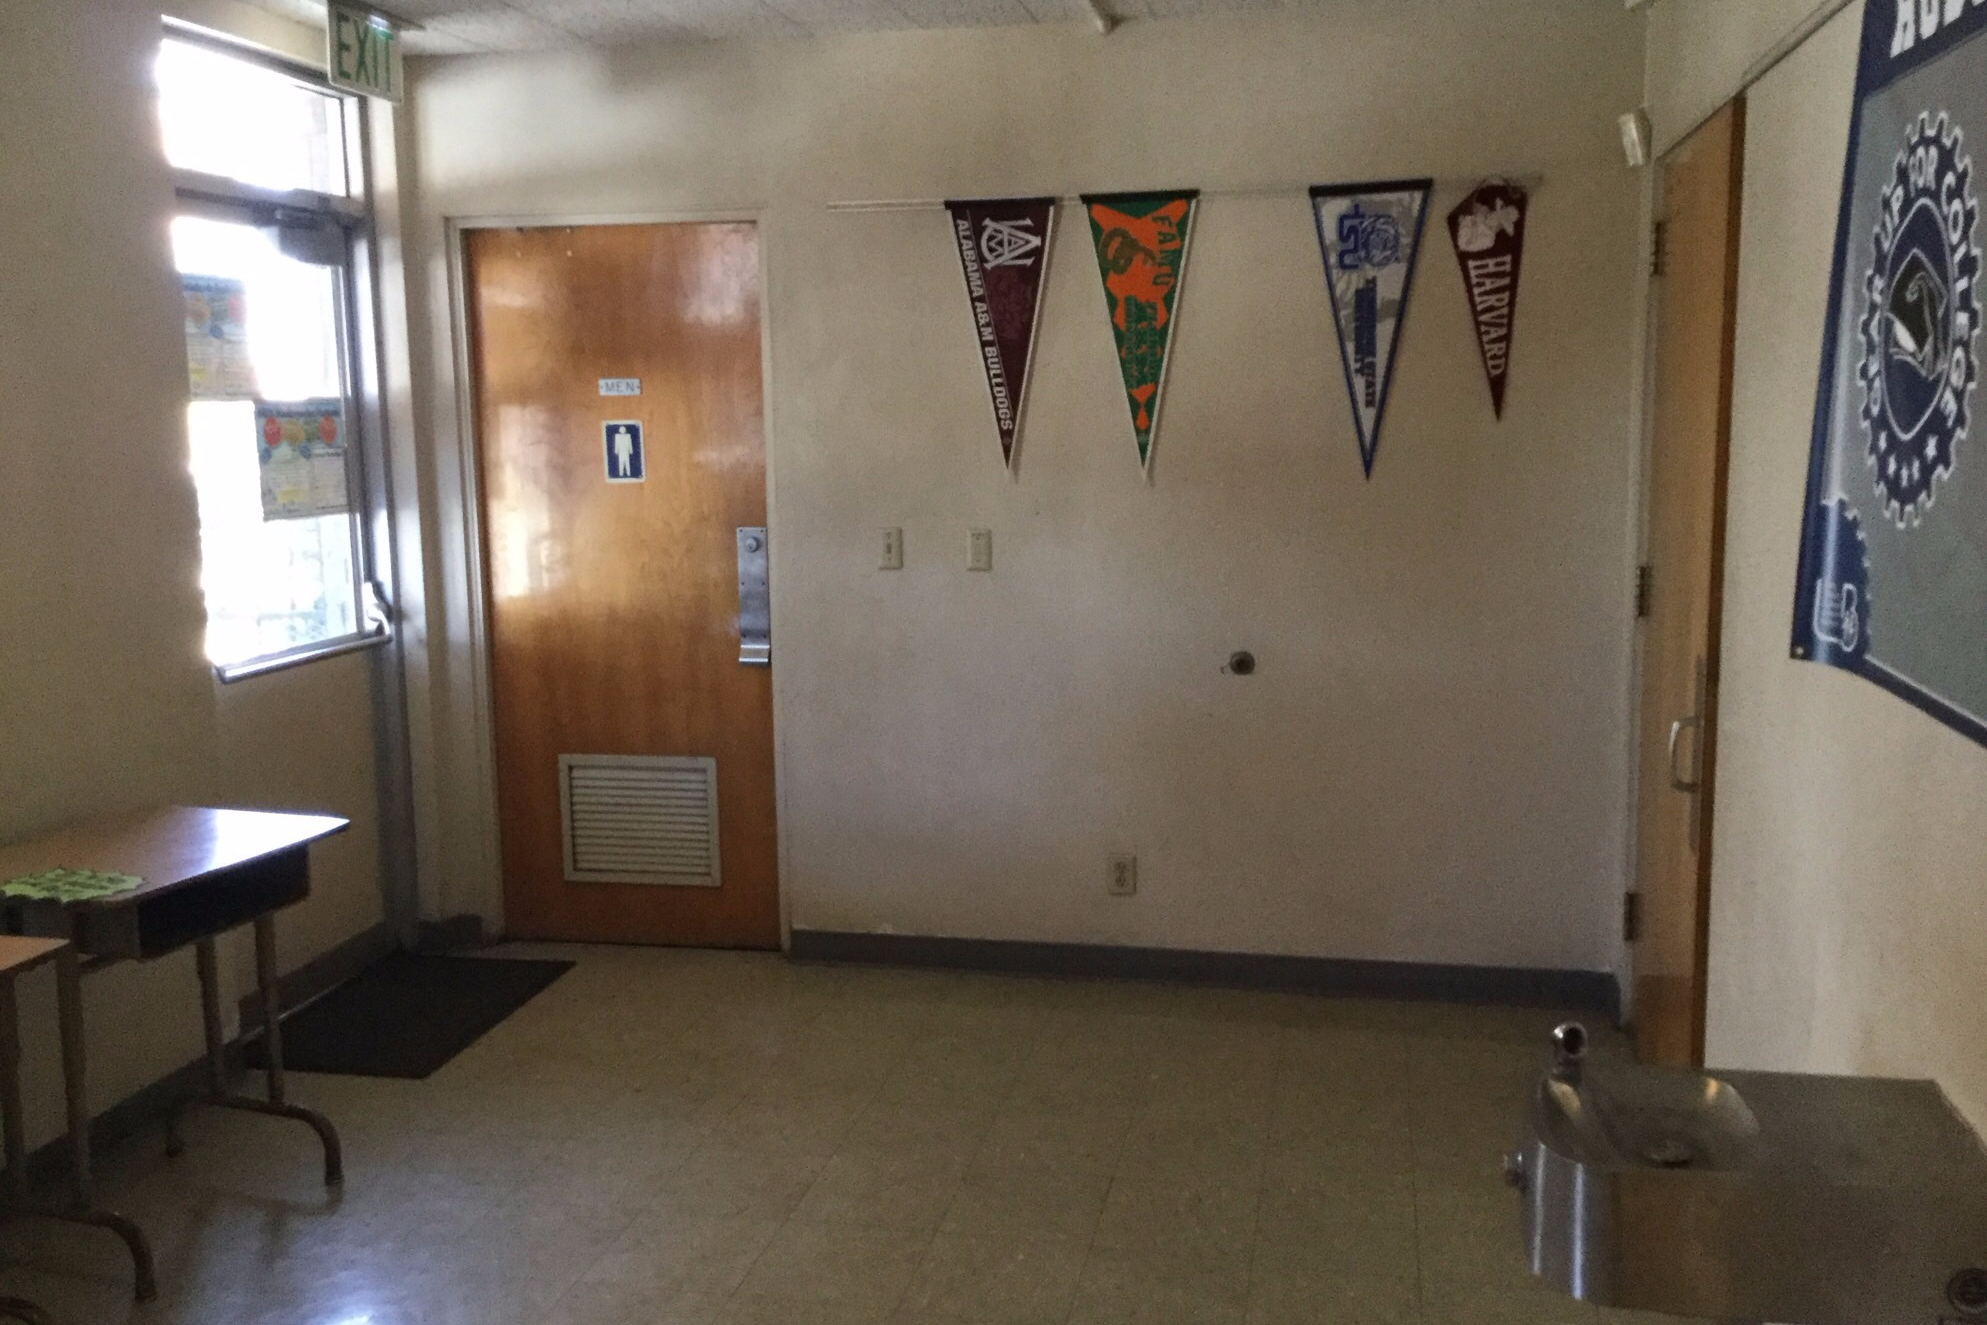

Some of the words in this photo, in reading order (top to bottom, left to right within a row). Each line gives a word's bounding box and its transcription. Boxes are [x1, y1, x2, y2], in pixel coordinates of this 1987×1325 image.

[336, 11, 394, 92] EXIT
[1151, 215, 1178, 286] FAMU
[1880, 184, 1905, 254] UP
[1908, 145, 1938, 198] FOR
[1941, 170, 1971, 430] COLLEGE
[957, 219, 985, 299] ALABAMA
[974, 301, 994, 342] A&M
[984, 346, 1013, 431] BULLDOGS
[1468, 253, 1513, 377] HARVARD
[604, 381, 635, 393] MEN
